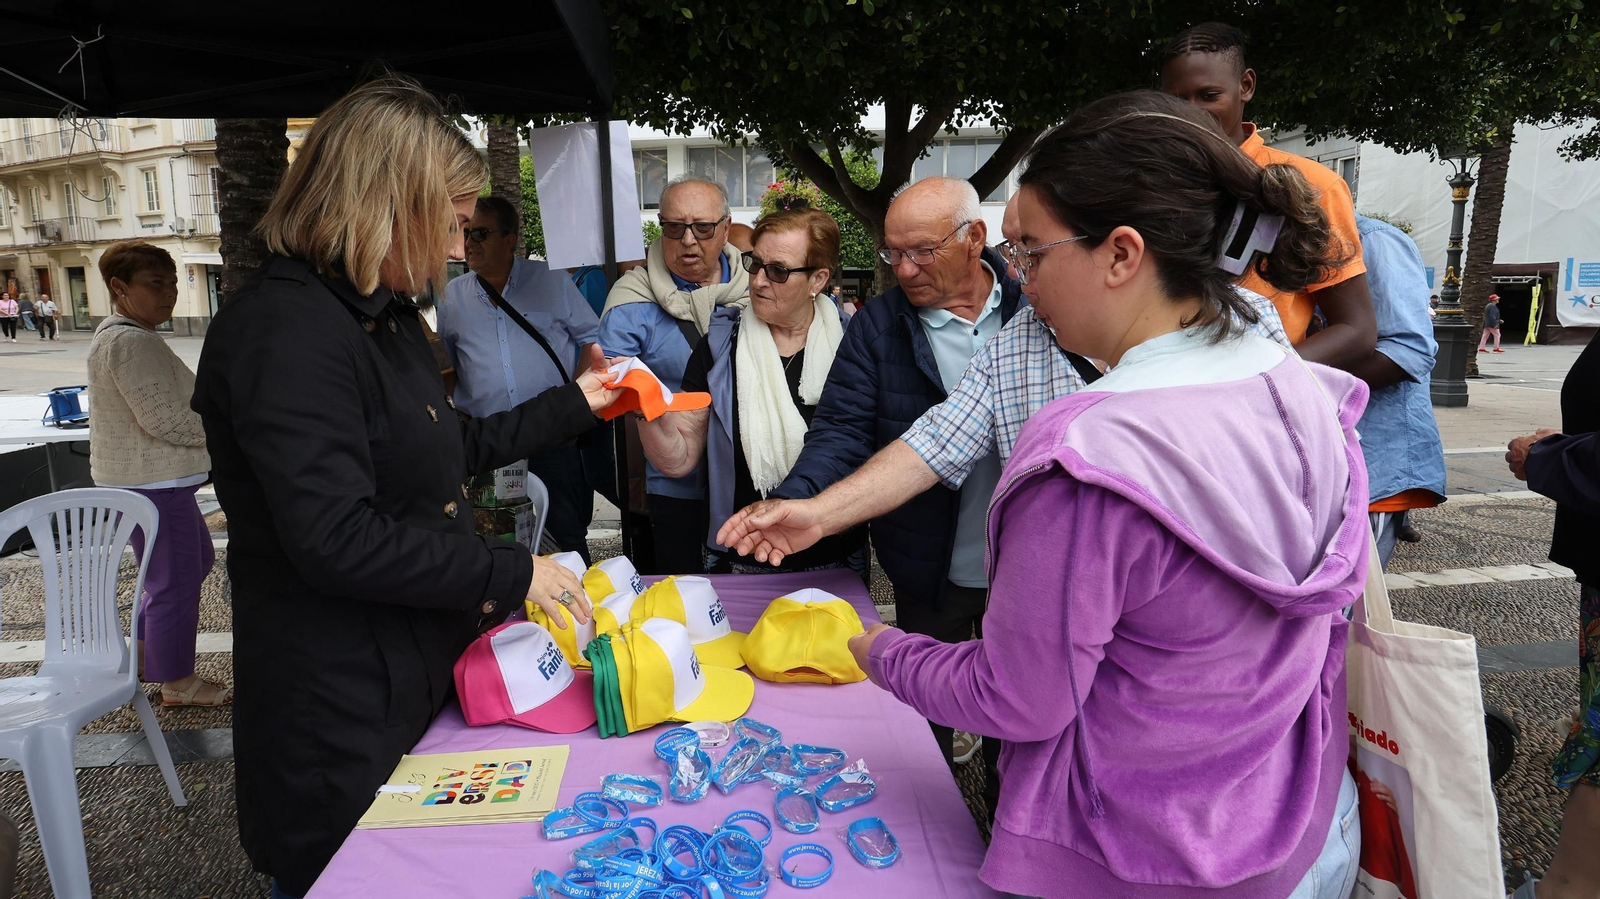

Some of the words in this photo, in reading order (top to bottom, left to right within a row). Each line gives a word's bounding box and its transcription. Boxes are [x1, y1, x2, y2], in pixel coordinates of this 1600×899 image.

[490, 760, 532, 804] DAD
[635, 865, 657, 879] JEREZ
[569, 887, 583, 895] por
[583, 889, 590, 897] la
